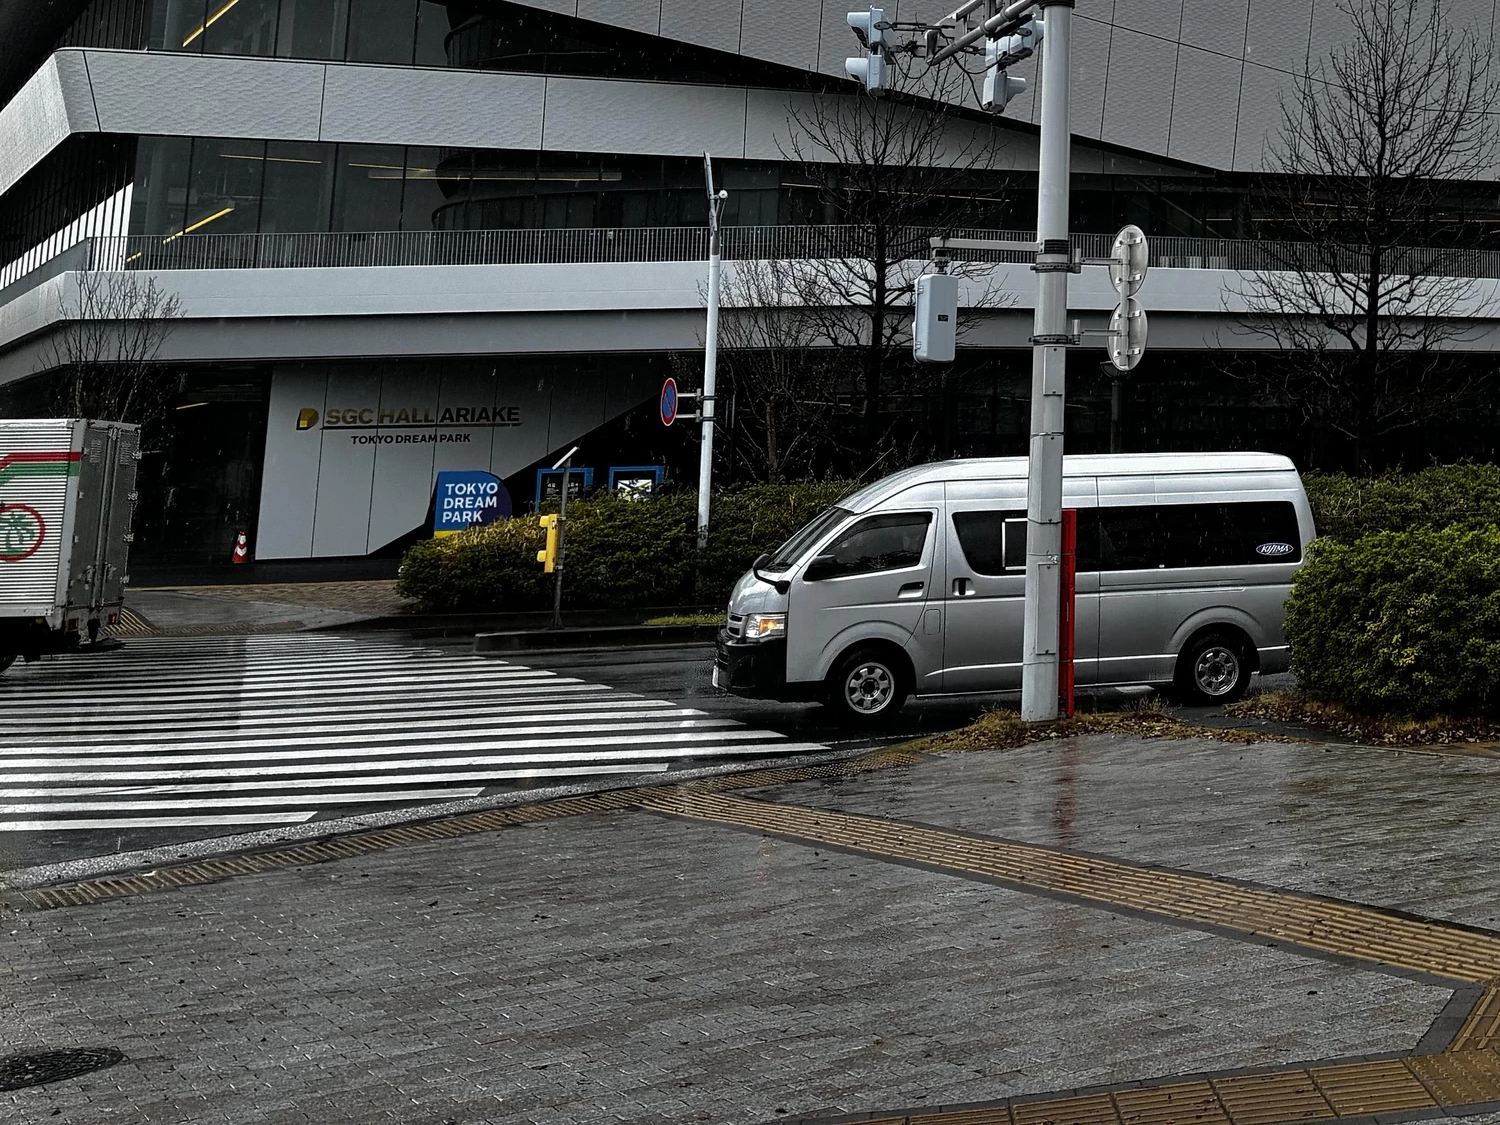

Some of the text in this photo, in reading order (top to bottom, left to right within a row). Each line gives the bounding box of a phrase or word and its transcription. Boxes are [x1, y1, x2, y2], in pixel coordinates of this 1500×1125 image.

[325, 406, 521, 425] SGC HALL ARIAKE
[351, 433, 471, 445] TOKYO DREAM PARK
[445, 482, 499, 496] TOKYO
[443, 496, 497, 509] DREAM
[442, 510, 483, 523] PARK
